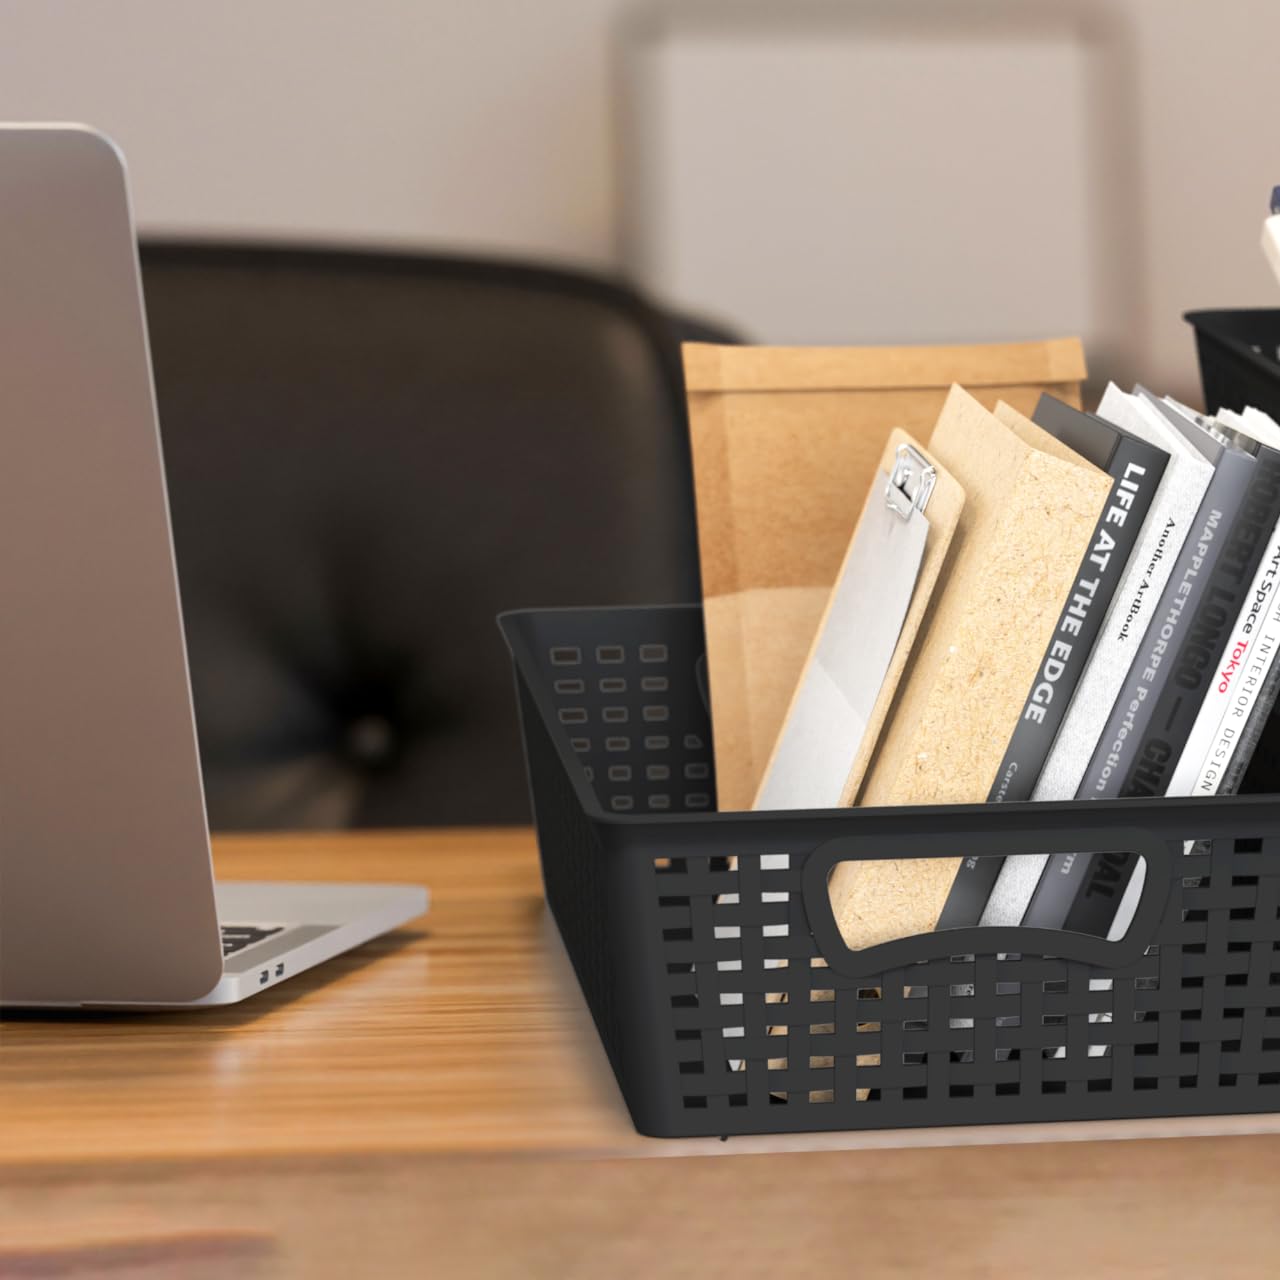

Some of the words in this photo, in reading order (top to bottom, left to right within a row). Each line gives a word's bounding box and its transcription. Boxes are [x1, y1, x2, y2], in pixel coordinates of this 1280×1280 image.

[1106, 462, 1146, 527] LIFE
[1090, 528, 1116, 572] AT
[1147, 517, 1175, 577] Another
[1061, 578, 1100, 637] THE
[1142, 509, 1222, 682] MAPPLETHORPE
[1024, 640, 1072, 724] EDGE
[1218, 640, 1249, 693] Tokyo
[1232, 634, 1275, 717] INTERIOR
[1096, 685, 1148, 792] Perfection
[1201, 728, 1235, 791] DESIGN
[995, 762, 1018, 802] Carste
